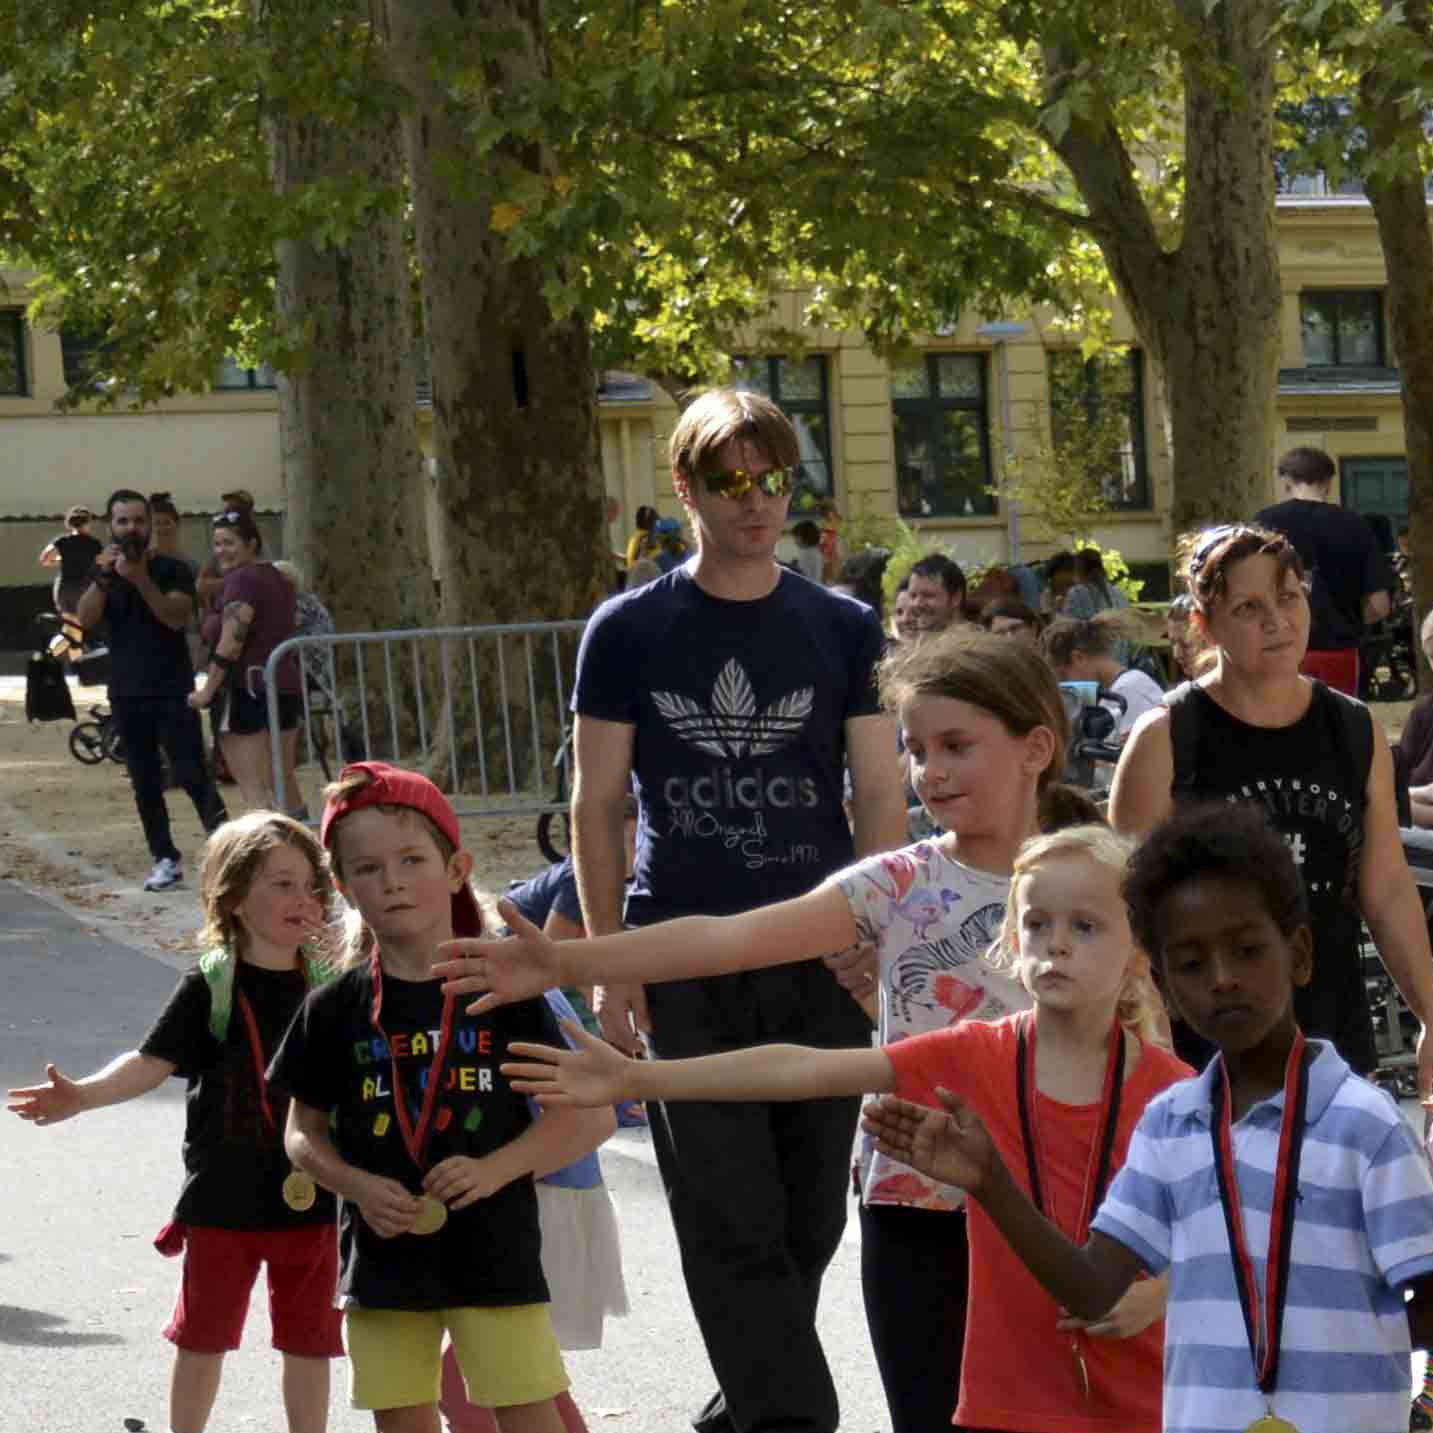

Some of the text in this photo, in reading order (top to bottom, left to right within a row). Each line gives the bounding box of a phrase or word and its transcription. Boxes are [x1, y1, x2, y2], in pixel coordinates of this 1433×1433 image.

[663, 767, 820, 809] adidas
[353, 1027, 494, 1065] CREATVE
[361, 1072, 392, 1102] AL
